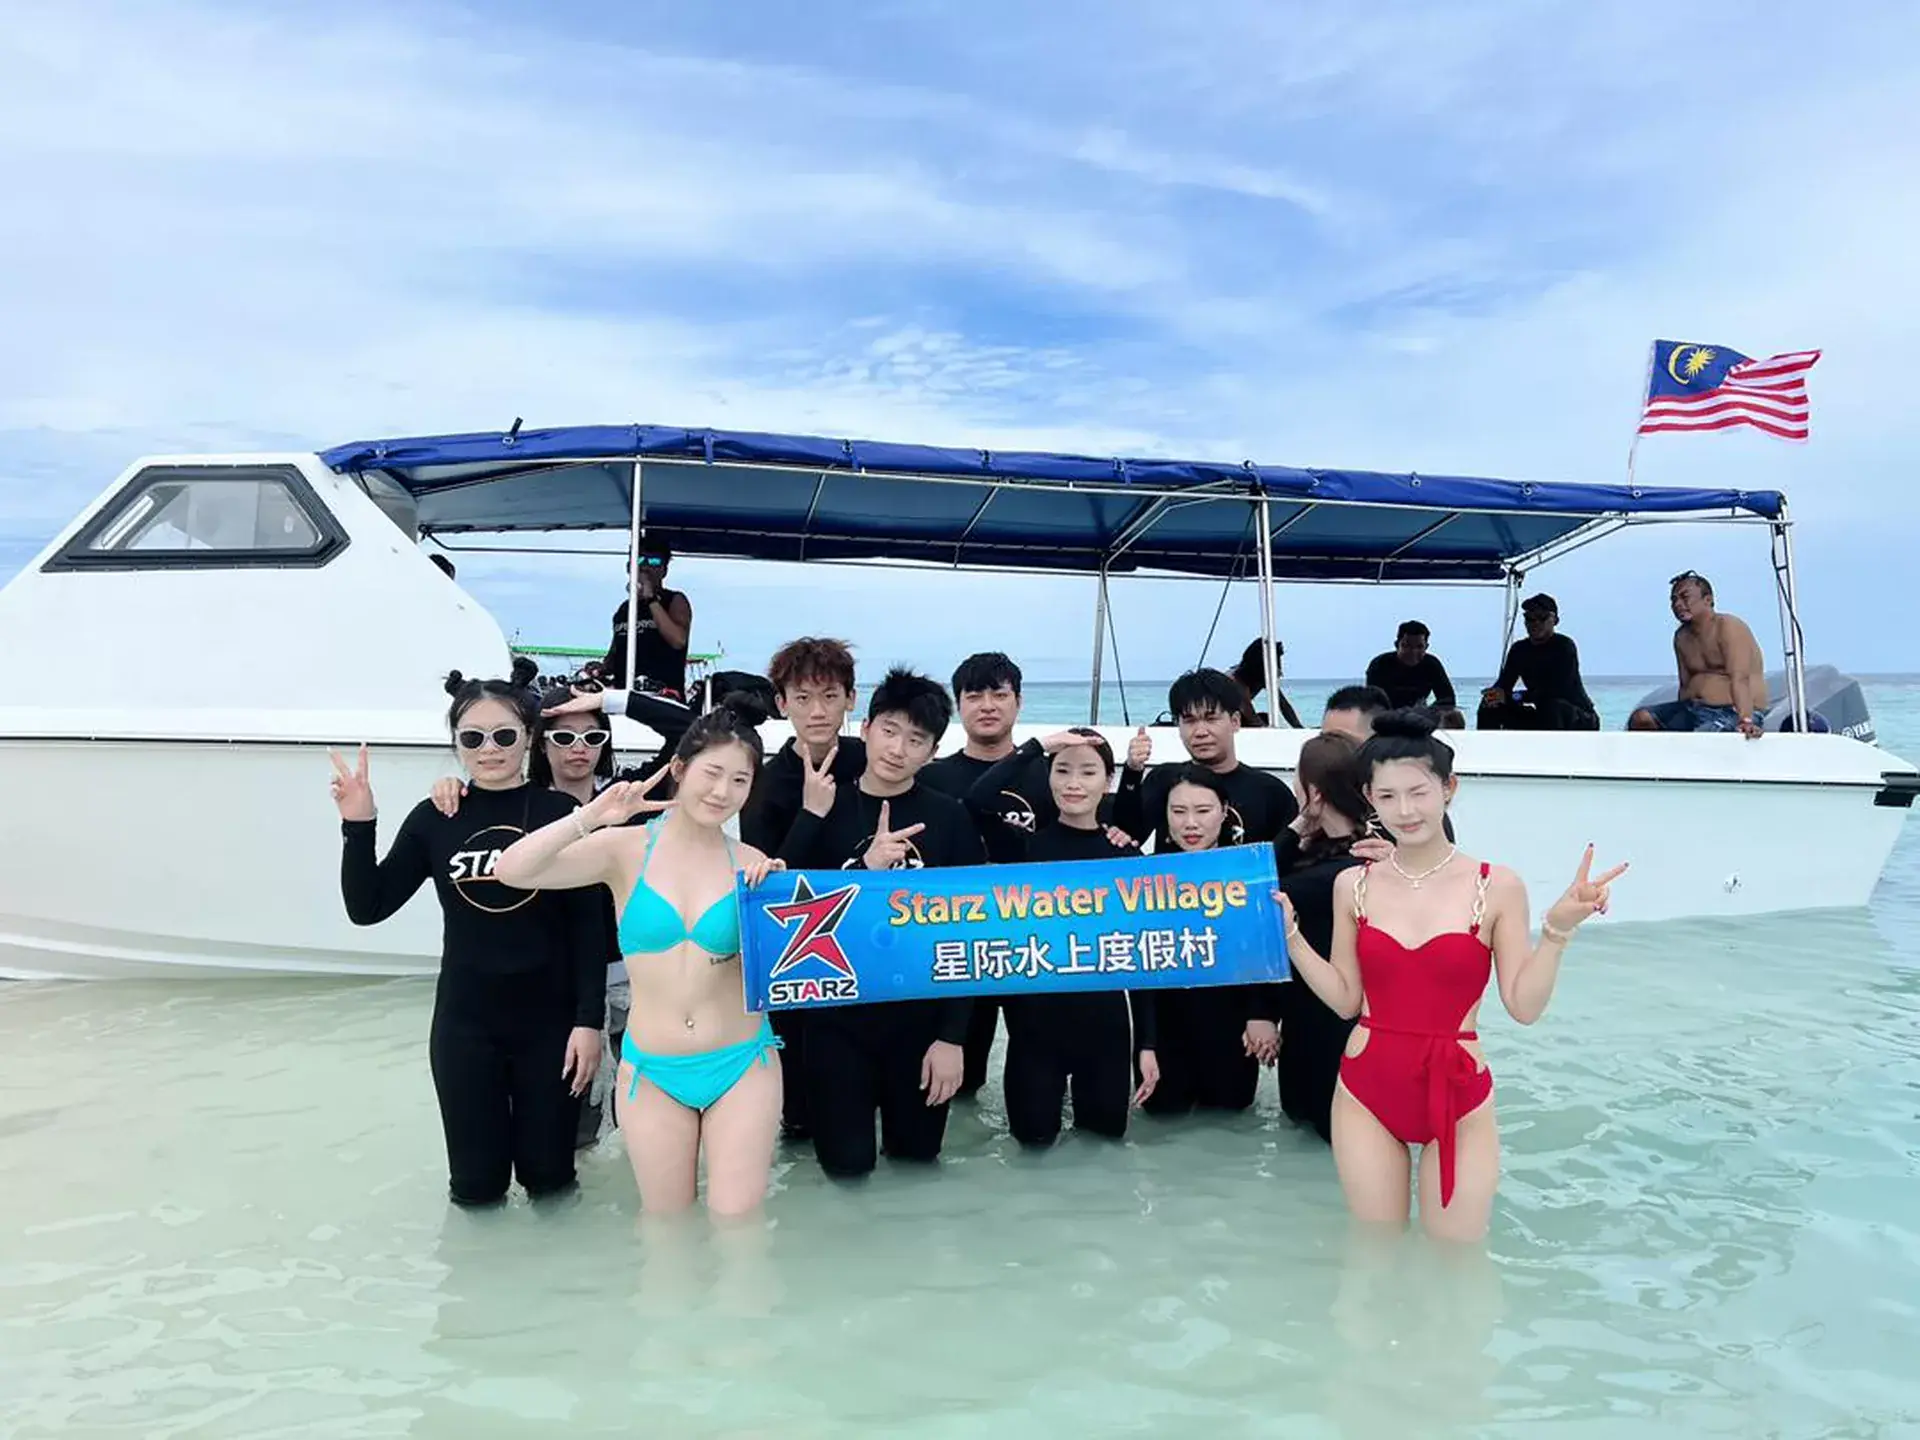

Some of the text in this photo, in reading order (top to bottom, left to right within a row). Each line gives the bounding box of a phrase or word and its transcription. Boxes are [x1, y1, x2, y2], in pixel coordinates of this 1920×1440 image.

[449, 849, 503, 879] STA
[889, 873, 1248, 926] Starz Water Village
[932, 926, 1218, 982] 星际水上度假村
[769, 978, 858, 1004] STARZ
